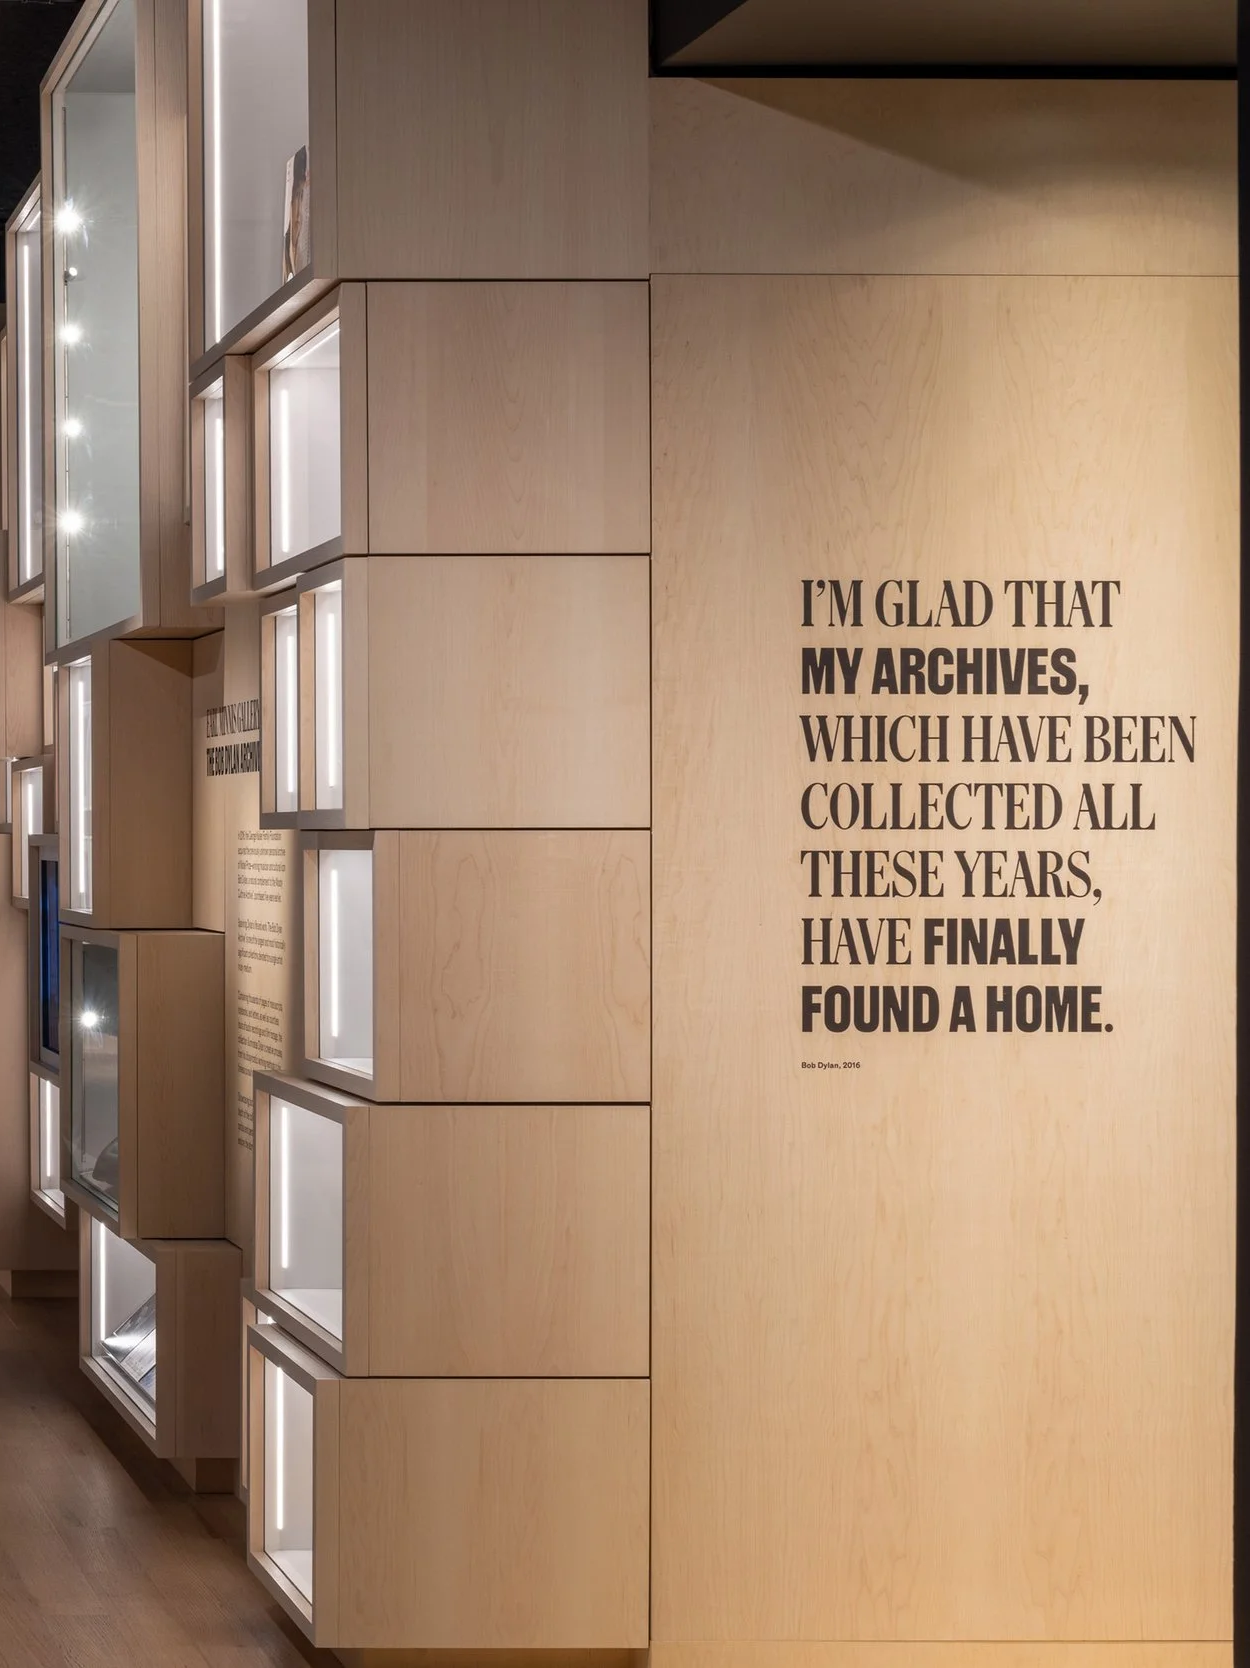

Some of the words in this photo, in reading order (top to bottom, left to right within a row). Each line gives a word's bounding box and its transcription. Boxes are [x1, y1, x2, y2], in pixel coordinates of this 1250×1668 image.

[875, 579, 993, 627] GLAD
[1005, 580, 1121, 627] THAT
[801, 648, 863, 695] MY
[871, 647, 1089, 705] ARCHIVES,
[799, 715, 949, 763] WHICH
[962, 716, 1072, 762] HAVE
[1084, 716, 1197, 762] BEEN
[800, 783, 1063, 830] COLLECTED
[1073, 784, 1156, 830] ALL
[801, 850, 944, 898] THESE
[954, 851, 1102, 905] YEARS,
[801, 918, 912, 965] HAVE
[924, 918, 1085, 965] FINALLY
[801, 985, 940, 1033] FOUND
[949, 985, 977, 1033] A
[986, 985, 1114, 1033] HOME.
[817, 1062, 841, 1070] Dylan,
